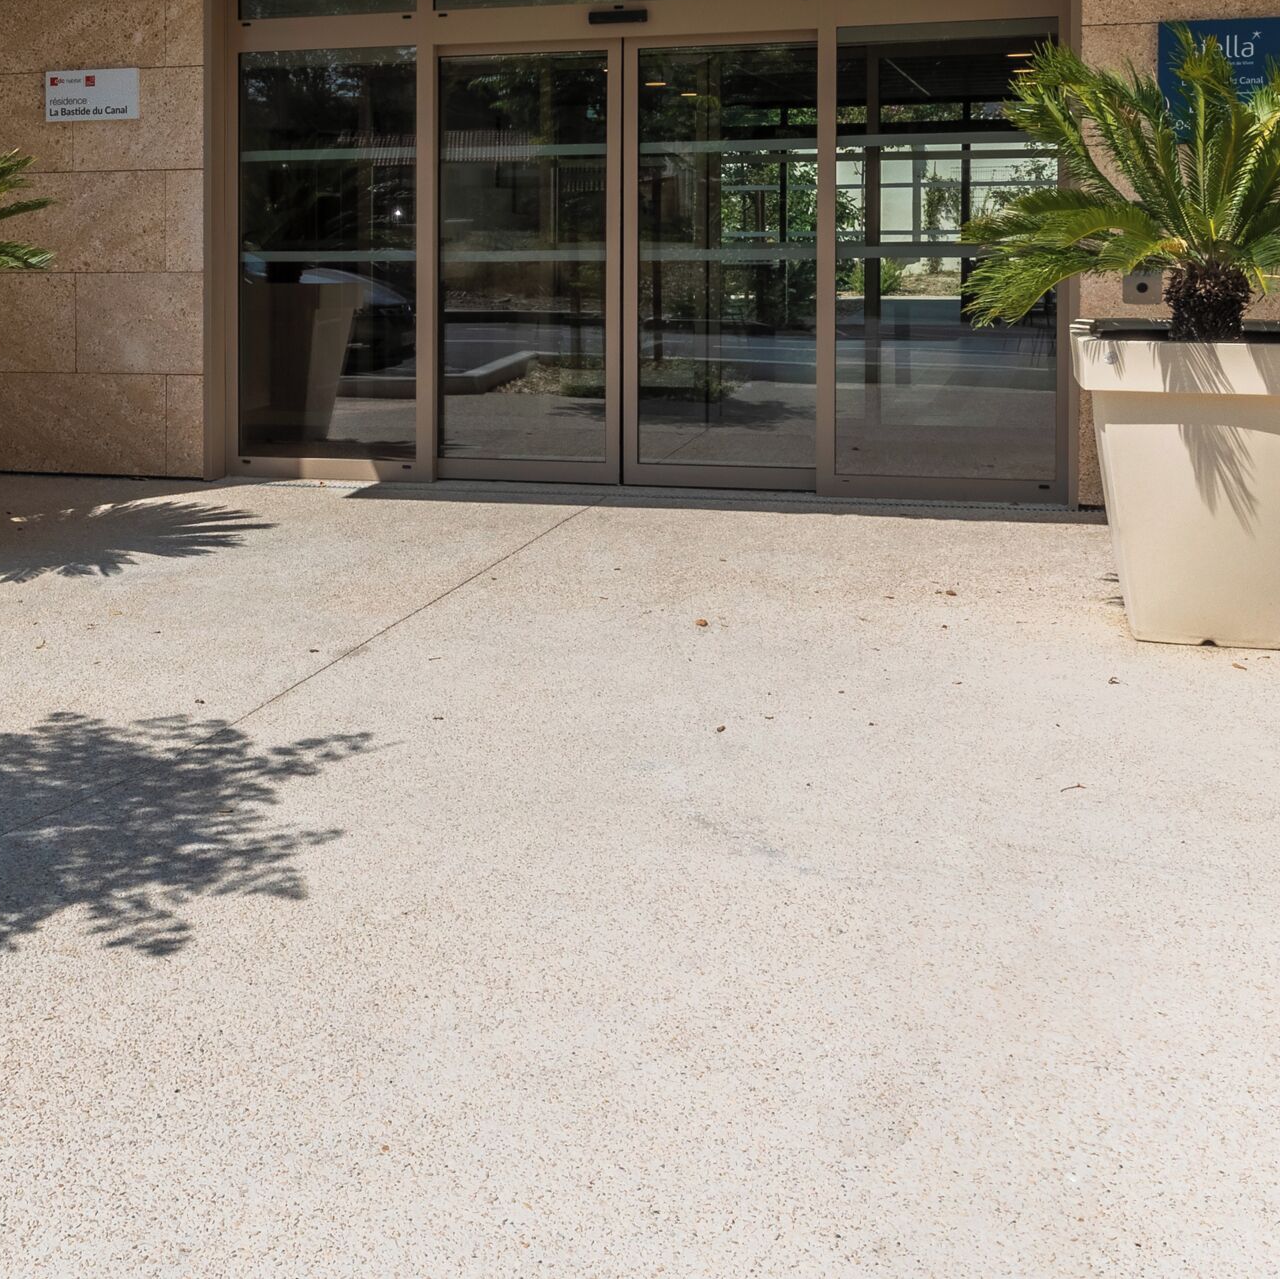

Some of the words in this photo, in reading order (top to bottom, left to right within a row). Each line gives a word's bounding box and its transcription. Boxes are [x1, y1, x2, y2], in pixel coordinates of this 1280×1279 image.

[1239, 76, 1264, 85] Canal
[49, 96, 88, 106] résidence
[49, 108, 59, 117] La
[61, 107, 91, 116] Bastide
[92, 106, 103, 115] du
[105, 105, 128, 115] Canal
